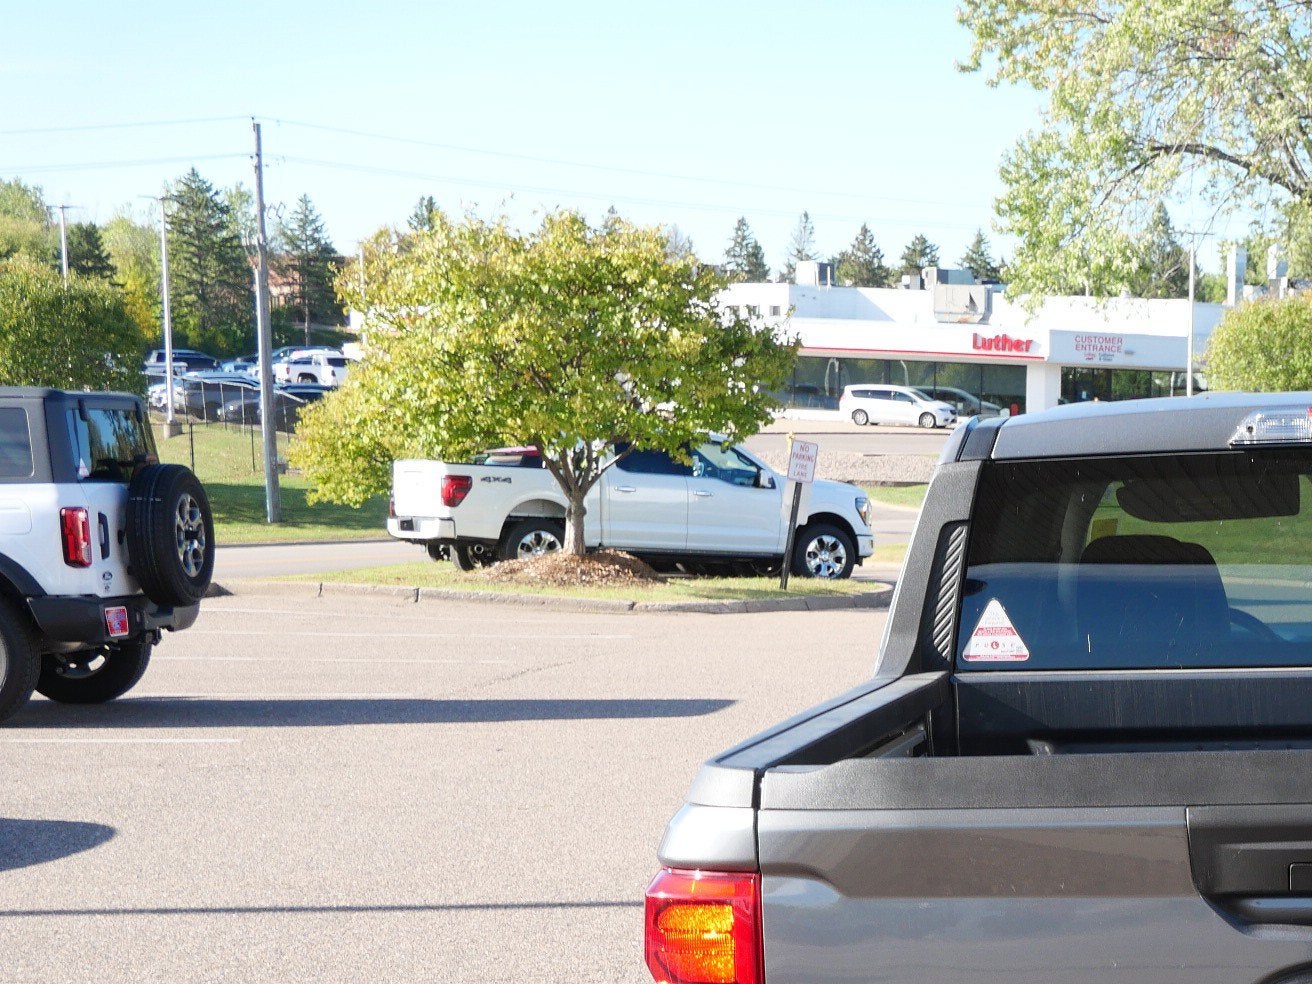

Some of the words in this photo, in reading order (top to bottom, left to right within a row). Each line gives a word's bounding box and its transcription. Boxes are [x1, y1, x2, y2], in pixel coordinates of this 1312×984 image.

[972, 332, 1033, 353] Luther
[1074, 335, 1123, 345] CUSTOMER
[1074, 344, 1122, 353] ENTRANCE
[799, 444, 810, 453] NO
